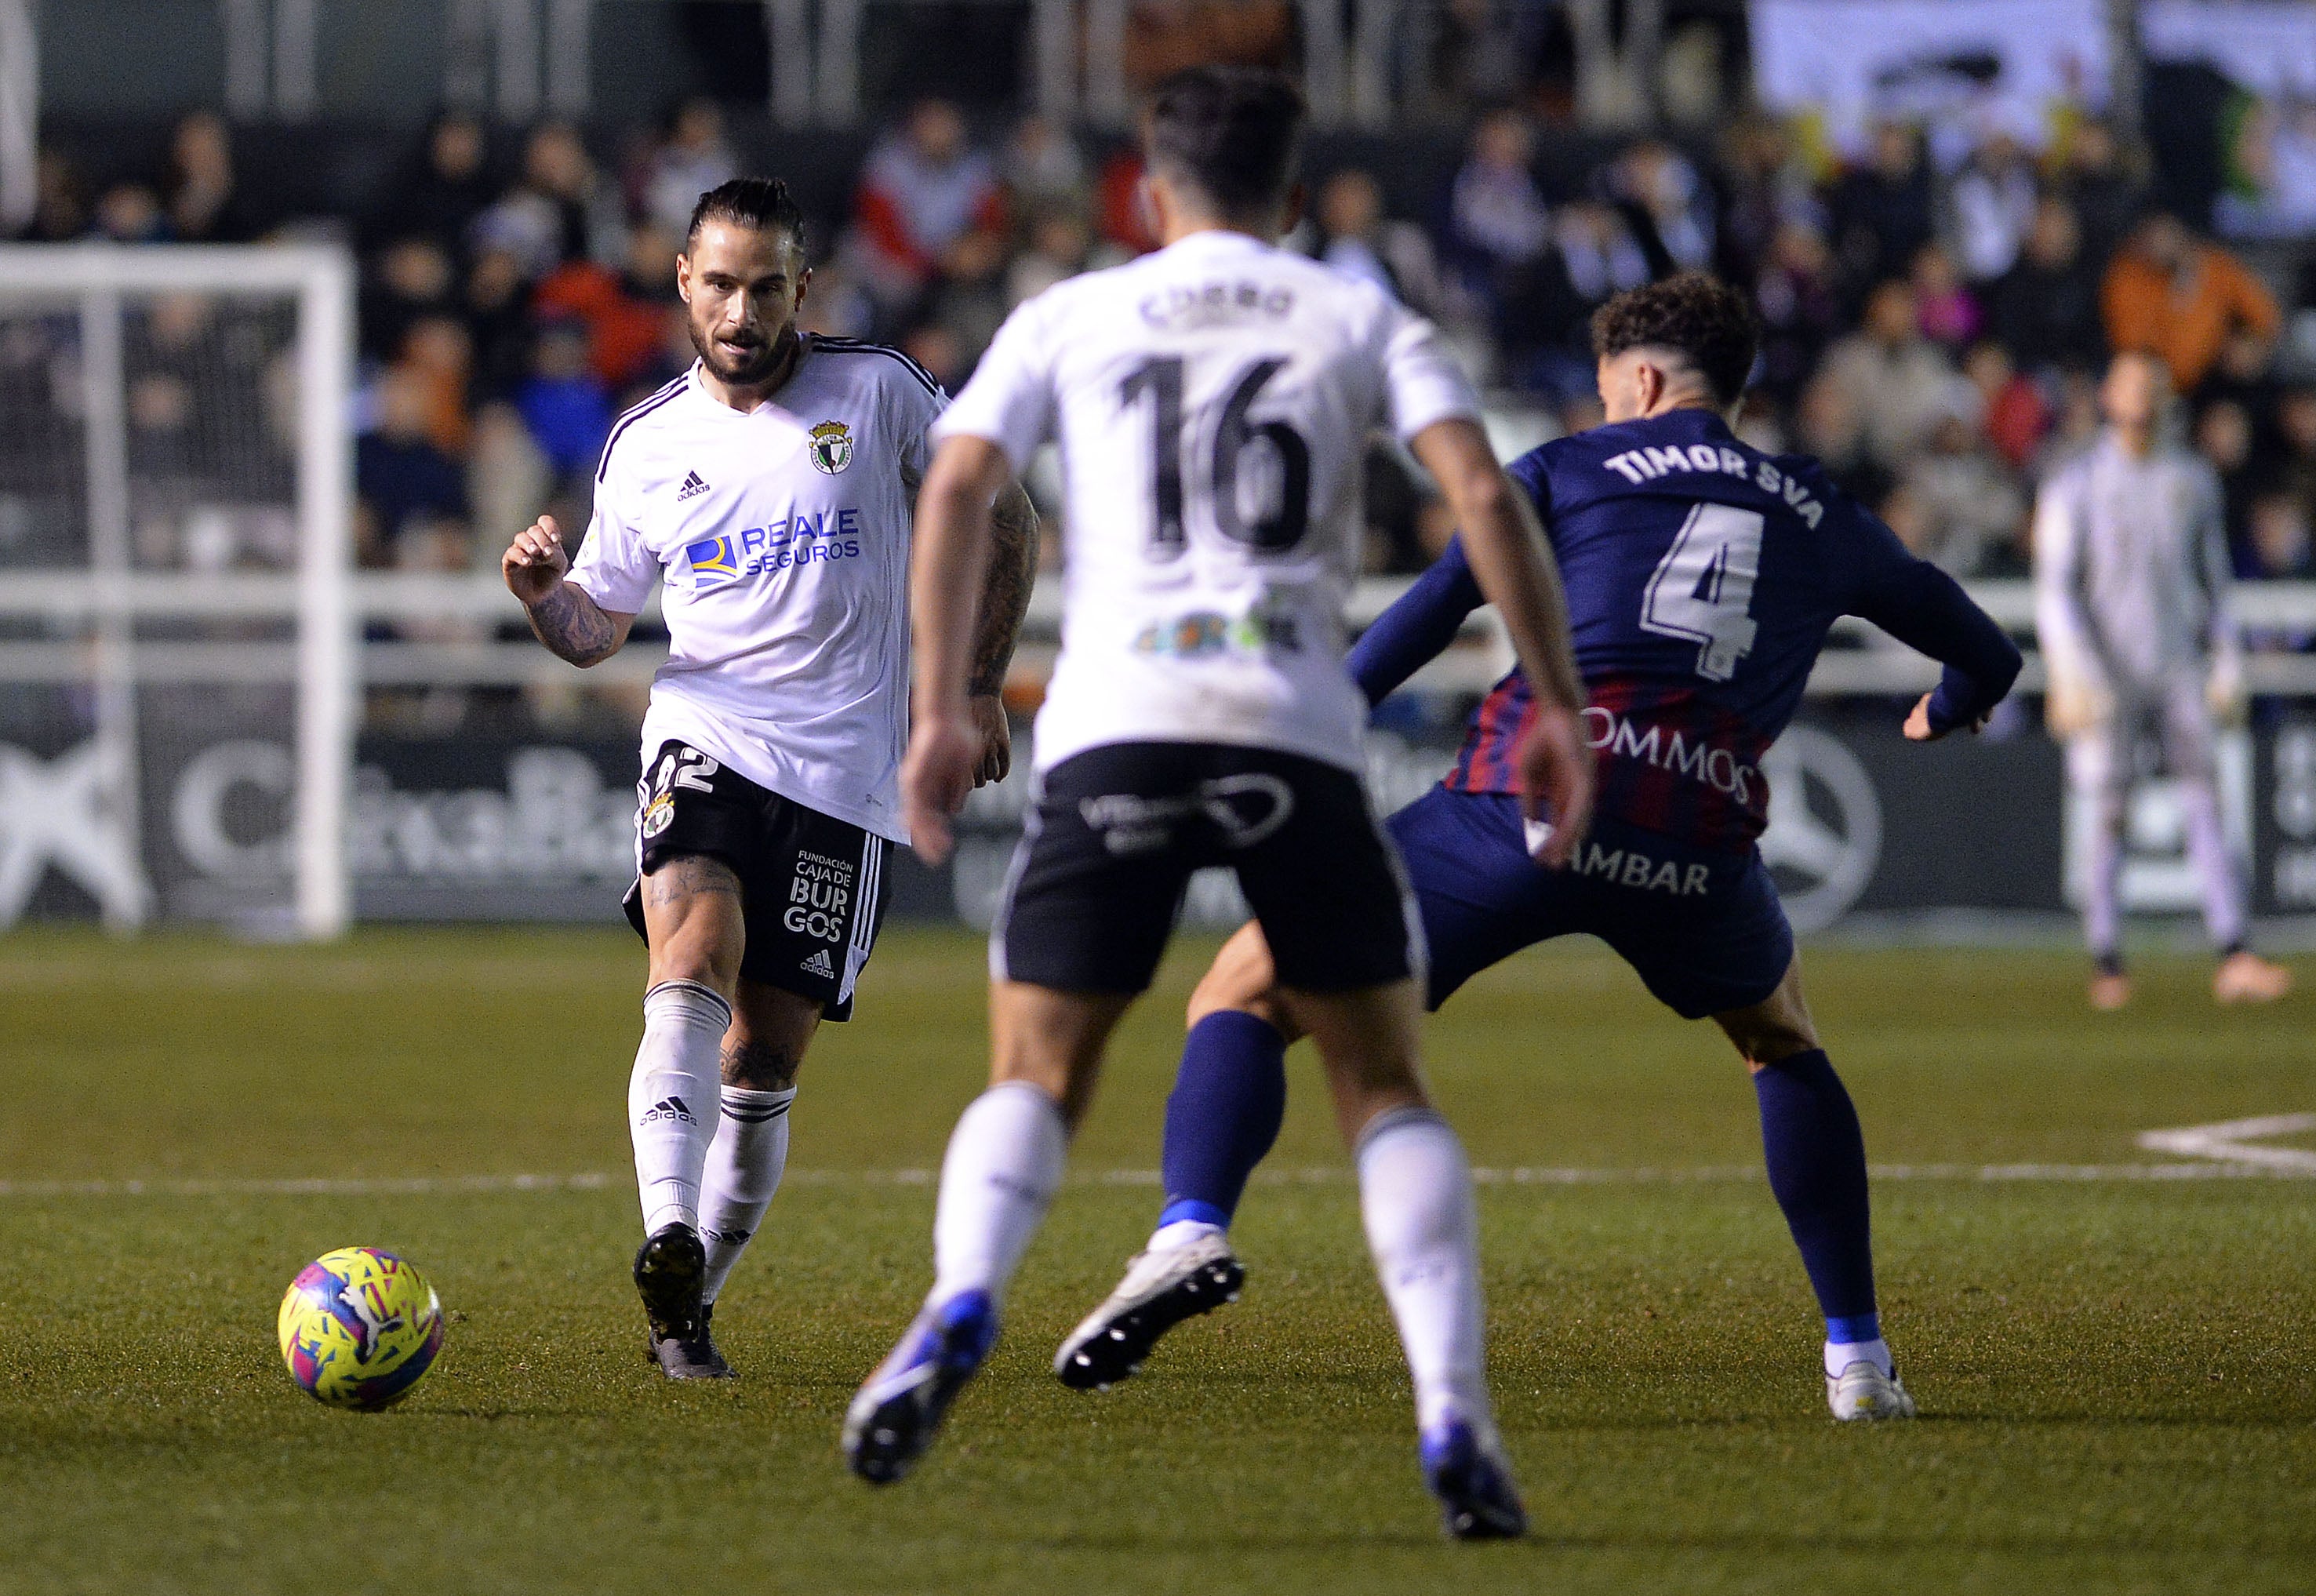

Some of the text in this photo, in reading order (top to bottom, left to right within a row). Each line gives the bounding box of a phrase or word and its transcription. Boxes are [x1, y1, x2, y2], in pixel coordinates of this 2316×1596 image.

[1119, 355, 1309, 554] 16
[1602, 444, 1748, 485] TIMOR
[677, 483, 711, 502] adidas
[741, 509, 859, 554] REALE
[746, 540, 860, 576] SEGUROS
[1638, 501, 1765, 683] 4
[1580, 706, 1754, 805] OMMOS
[796, 861, 851, 887] CAJA DE
[798, 850, 853, 873] FUNDACIÓN
[790, 876, 848, 916] BUR
[784, 906, 842, 943] GOS
[800, 962, 834, 979] adidas
[640, 1109, 697, 1126] adidas
